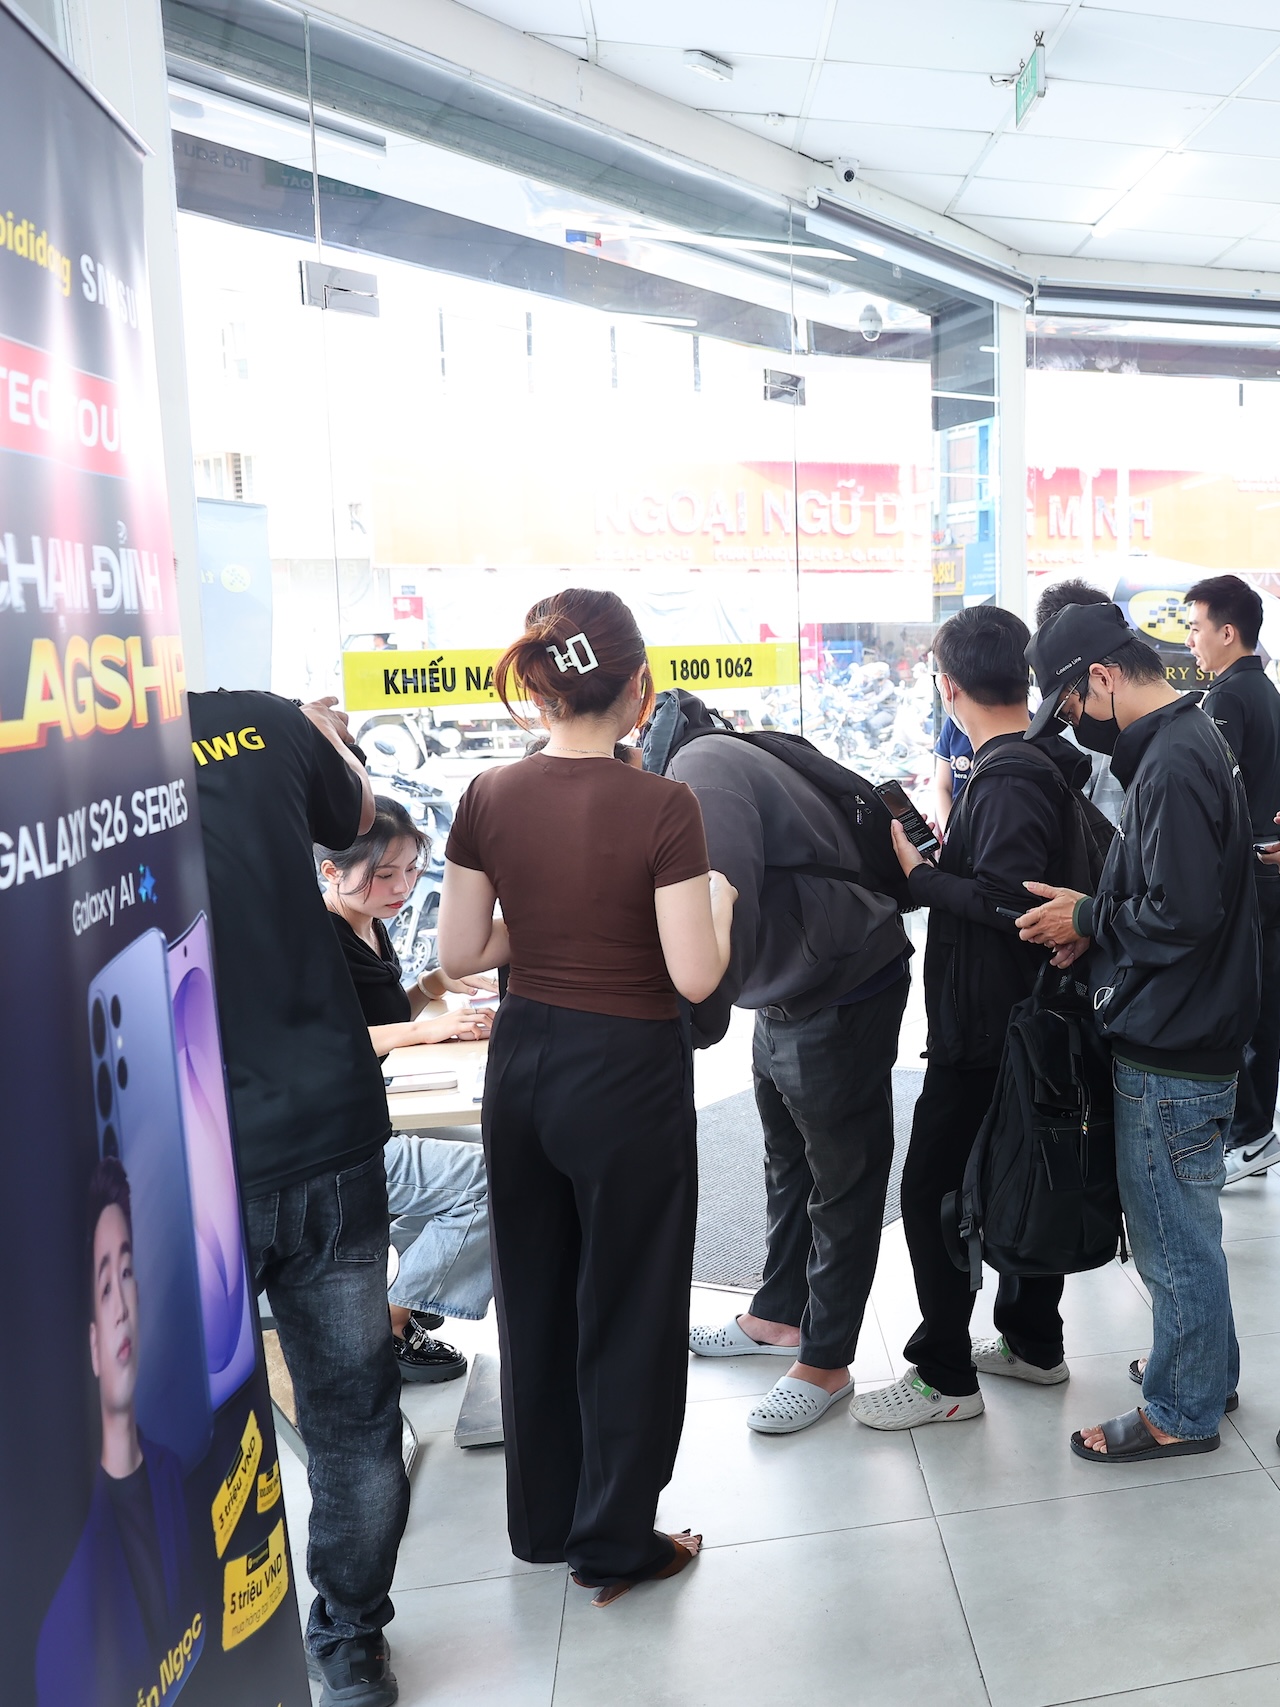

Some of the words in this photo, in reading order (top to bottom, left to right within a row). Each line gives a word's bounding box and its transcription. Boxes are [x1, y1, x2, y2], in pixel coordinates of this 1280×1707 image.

[594, 489, 748, 543] NGOẠI
[761, 478, 866, 537] NGỮ
[382, 655, 457, 696] KHIẾU
[669, 658, 710, 681] 1800
[715, 656, 753, 679] 1062
[0, 805, 88, 891] GALAXY
[89, 794, 129, 852] S26
[131, 777, 189, 838] SERIES
[72, 884, 116, 937] Galaxy
[119, 872, 136, 911] AI
[218, 1514, 226, 1530] 3
[241, 1436, 256, 1475] VND
[230, 1592, 237, 1615] 5
[238, 1579, 263, 1610] triệu
[264, 1554, 283, 1590] VND
[159, 1612, 203, 1696] Ngọc
